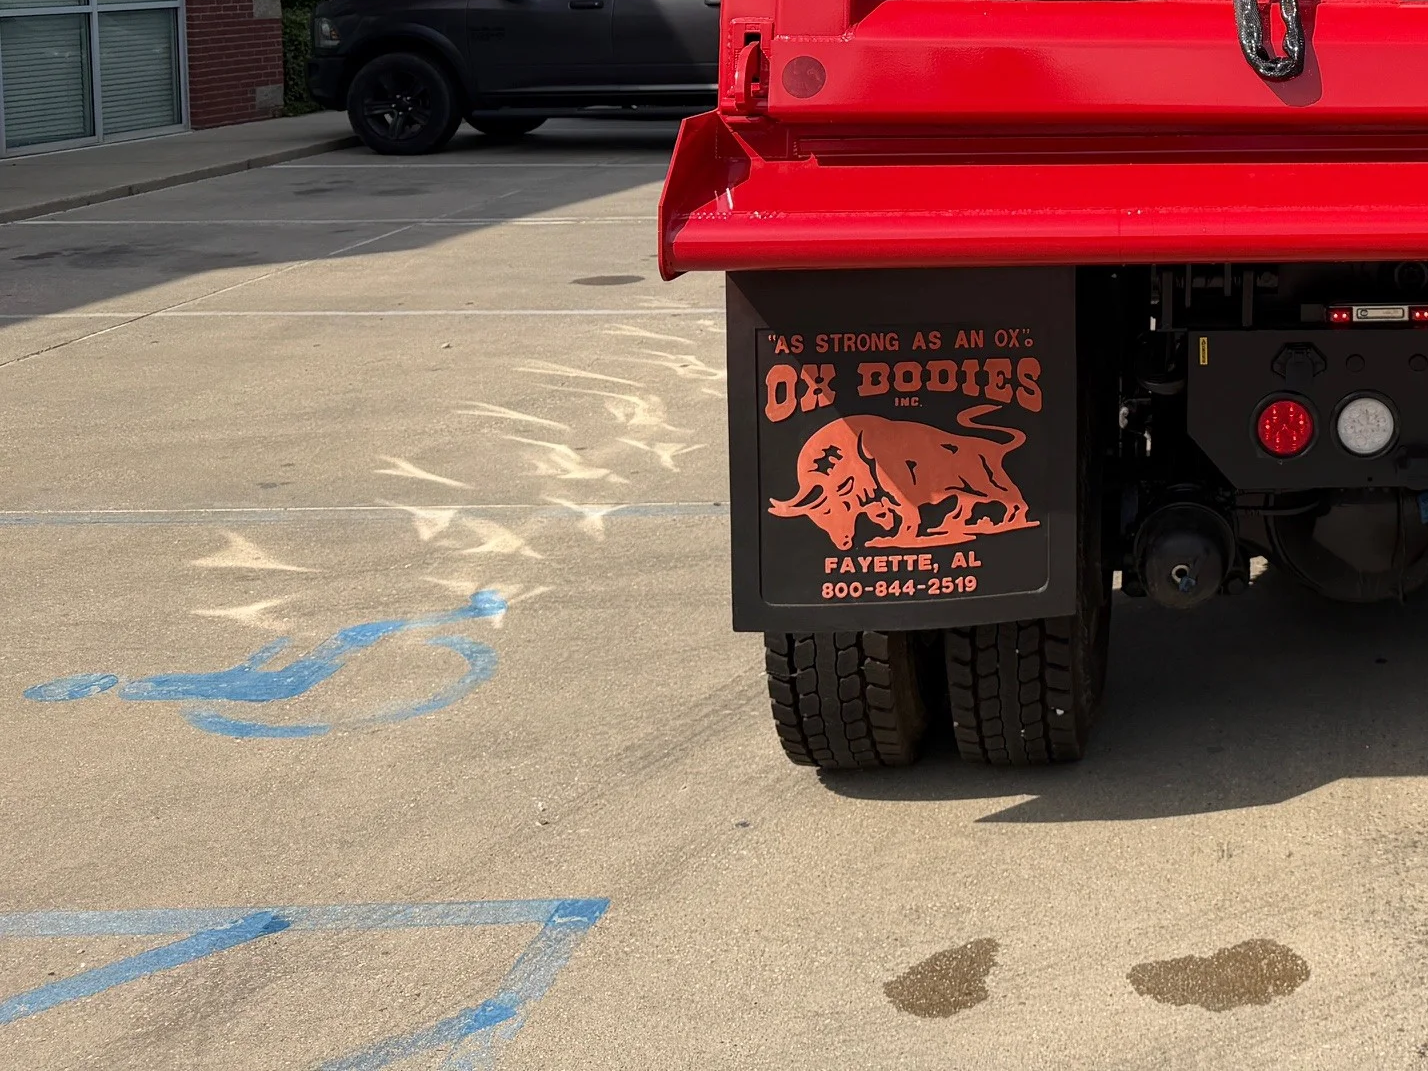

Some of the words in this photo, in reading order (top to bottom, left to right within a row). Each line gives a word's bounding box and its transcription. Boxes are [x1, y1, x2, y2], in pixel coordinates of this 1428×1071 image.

[816, 332, 899, 353] STRONG
[912, 330, 942, 351] AS
[955, 329, 984, 349] AN
[765, 364, 836, 422] OX
[857, 357, 1043, 412] BODIES
[824, 553, 939, 574] FAYETTE,
[951, 551, 982, 568] AL
[821, 575, 978, 599] 800-844-2519
